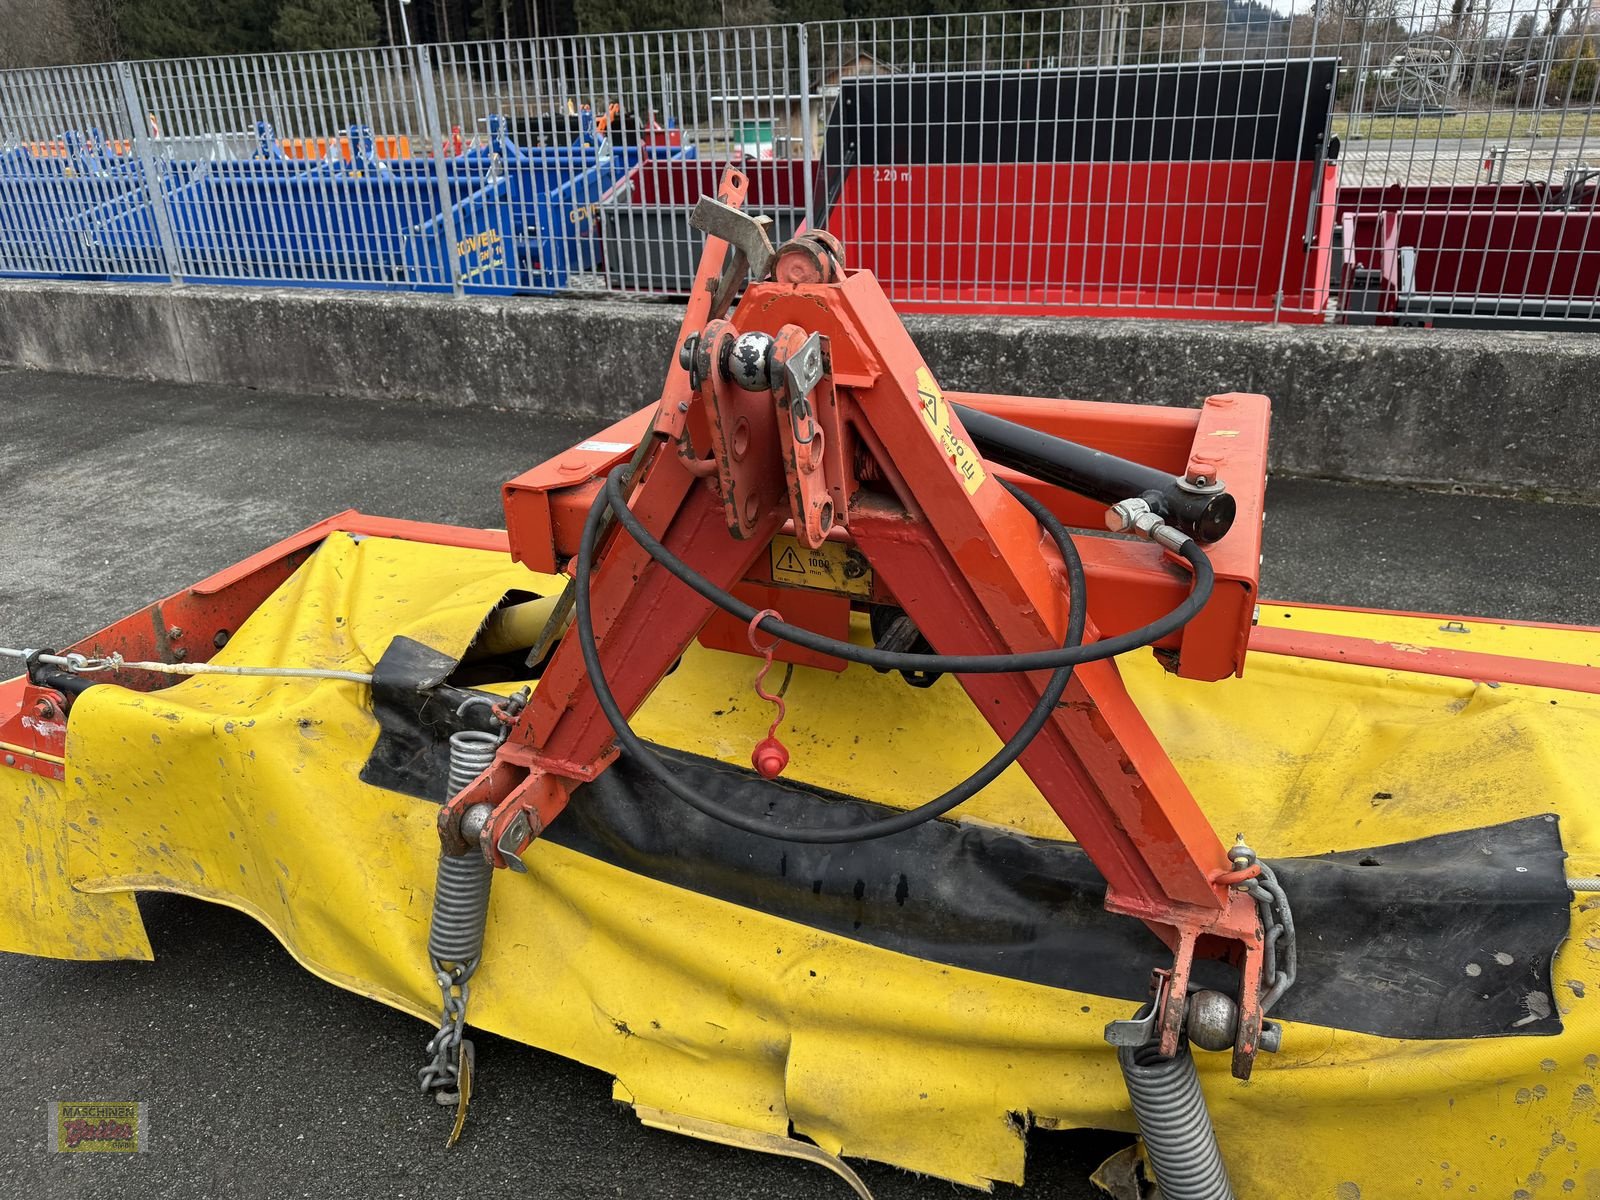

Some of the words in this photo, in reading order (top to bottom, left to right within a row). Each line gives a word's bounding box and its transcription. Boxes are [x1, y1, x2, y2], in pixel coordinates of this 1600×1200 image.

[873, 169, 897, 181] 2.20
[901, 172, 912, 181] m
[943, 425, 965, 457] 200
[808, 558, 830, 568] 1000
